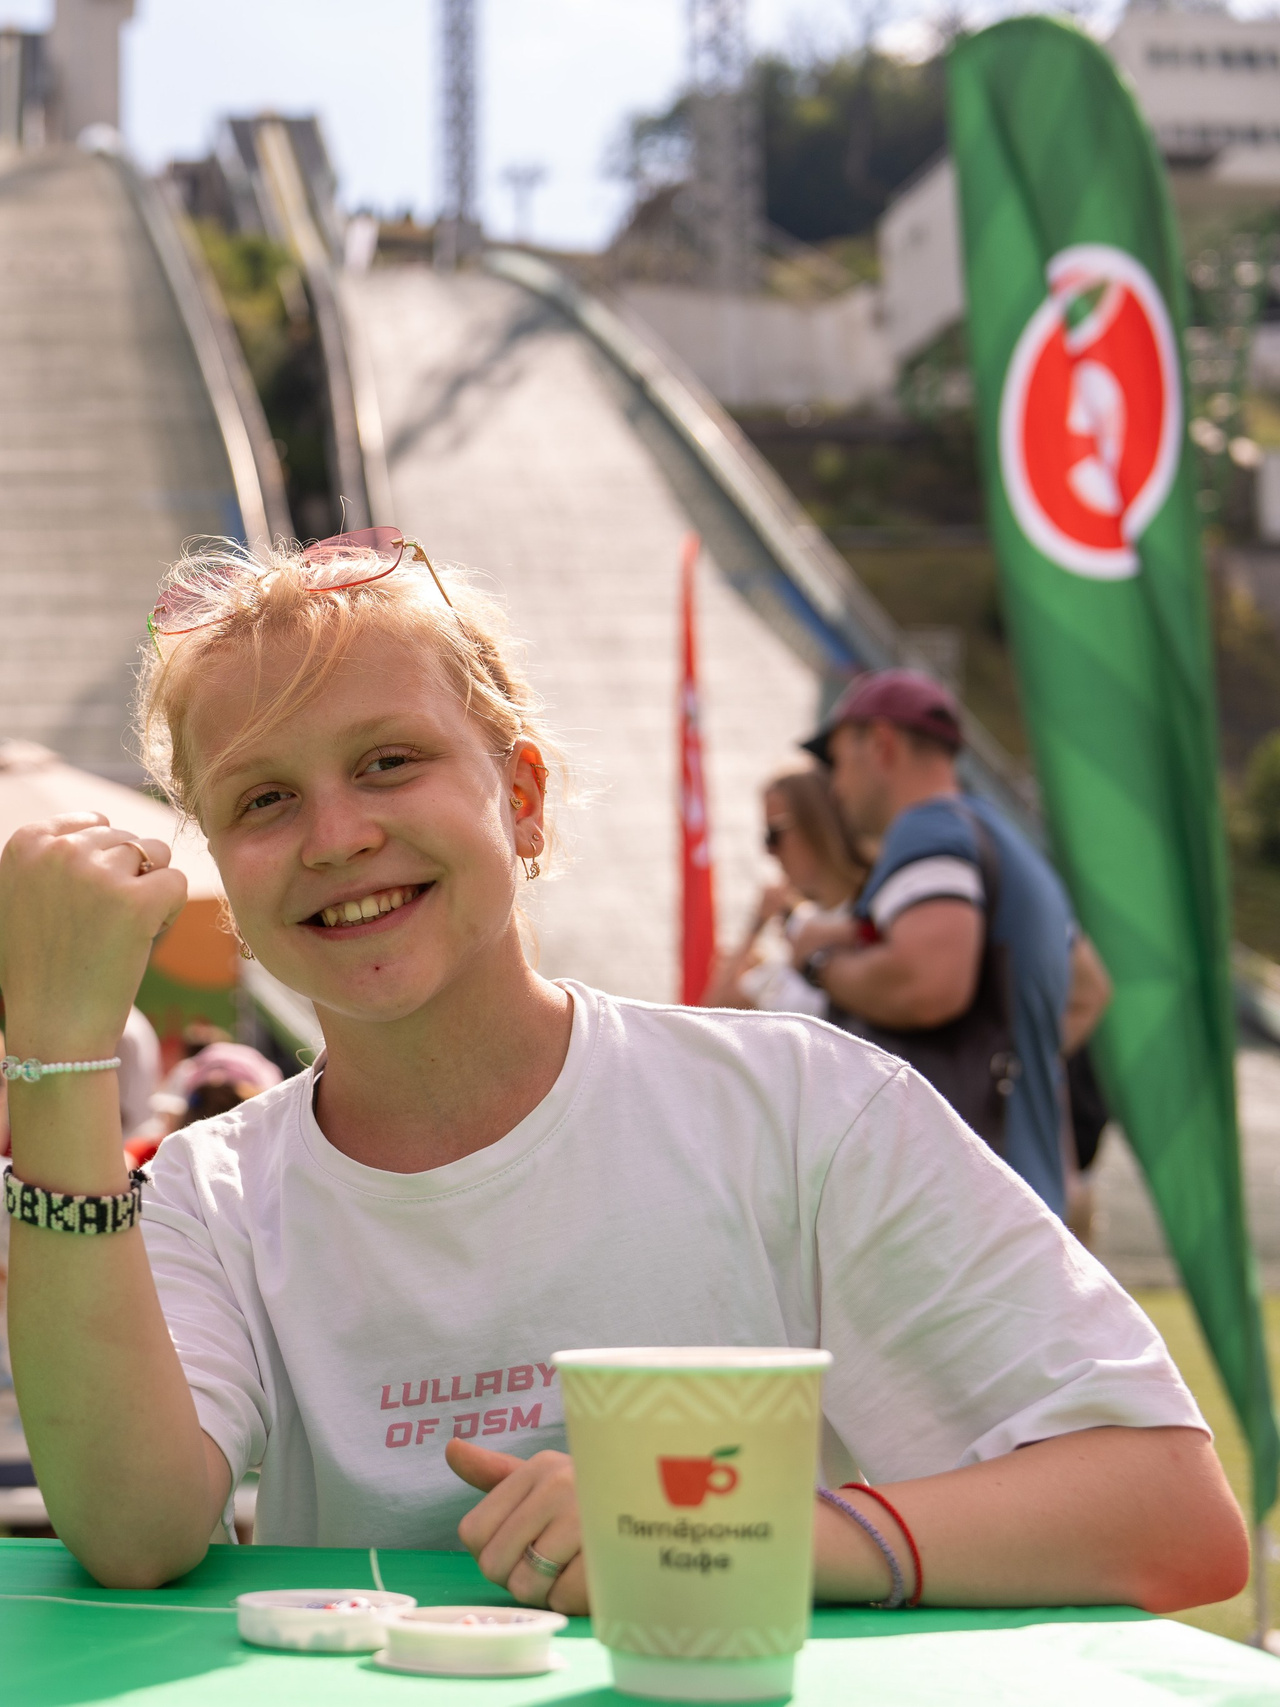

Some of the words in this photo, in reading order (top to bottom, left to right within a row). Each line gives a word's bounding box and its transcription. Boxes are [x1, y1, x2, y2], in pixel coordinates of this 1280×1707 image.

[380, 1362, 558, 1410] LULLABY
[385, 1418, 440, 1448] OF
[453, 1403, 543, 1439] DSM
[617, 1514, 771, 1543] Пятёрочка
[659, 1547, 731, 1573] Кафе
